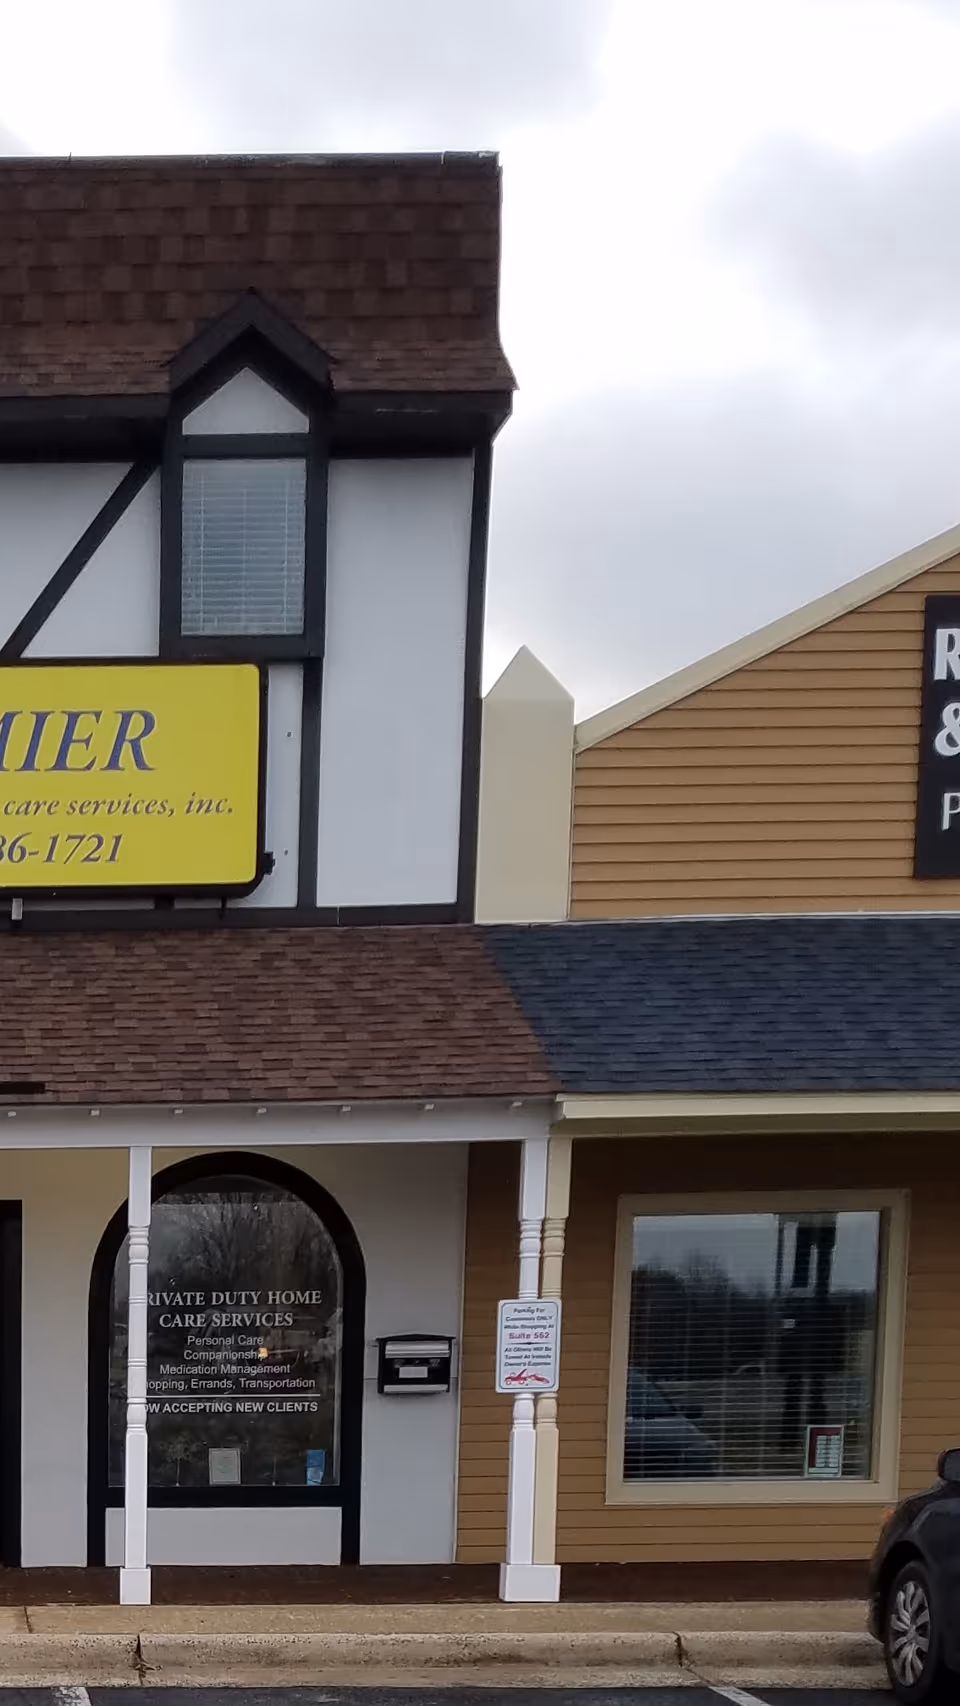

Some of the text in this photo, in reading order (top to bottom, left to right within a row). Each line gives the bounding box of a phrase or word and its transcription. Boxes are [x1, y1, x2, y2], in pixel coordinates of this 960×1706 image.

[4, 796, 60, 817] care
[66, 795, 175, 818] services,
[185, 792, 234, 816] inc.
[147, 1290, 322, 1306] RIVATE DUTY HOME
[159, 1312, 293, 1328] CARE SERVICES
[187, 1335, 264, 1345] Personal Care
[159, 1364, 291, 1376] Medication Management
[146, 1378, 315, 1391] opping, Errands, Transportation
[162, 1402, 233, 1413] ACCEPTING
[236, 1402, 264, 1412] NEW
[267, 1401, 318, 1412] CLIENTS
